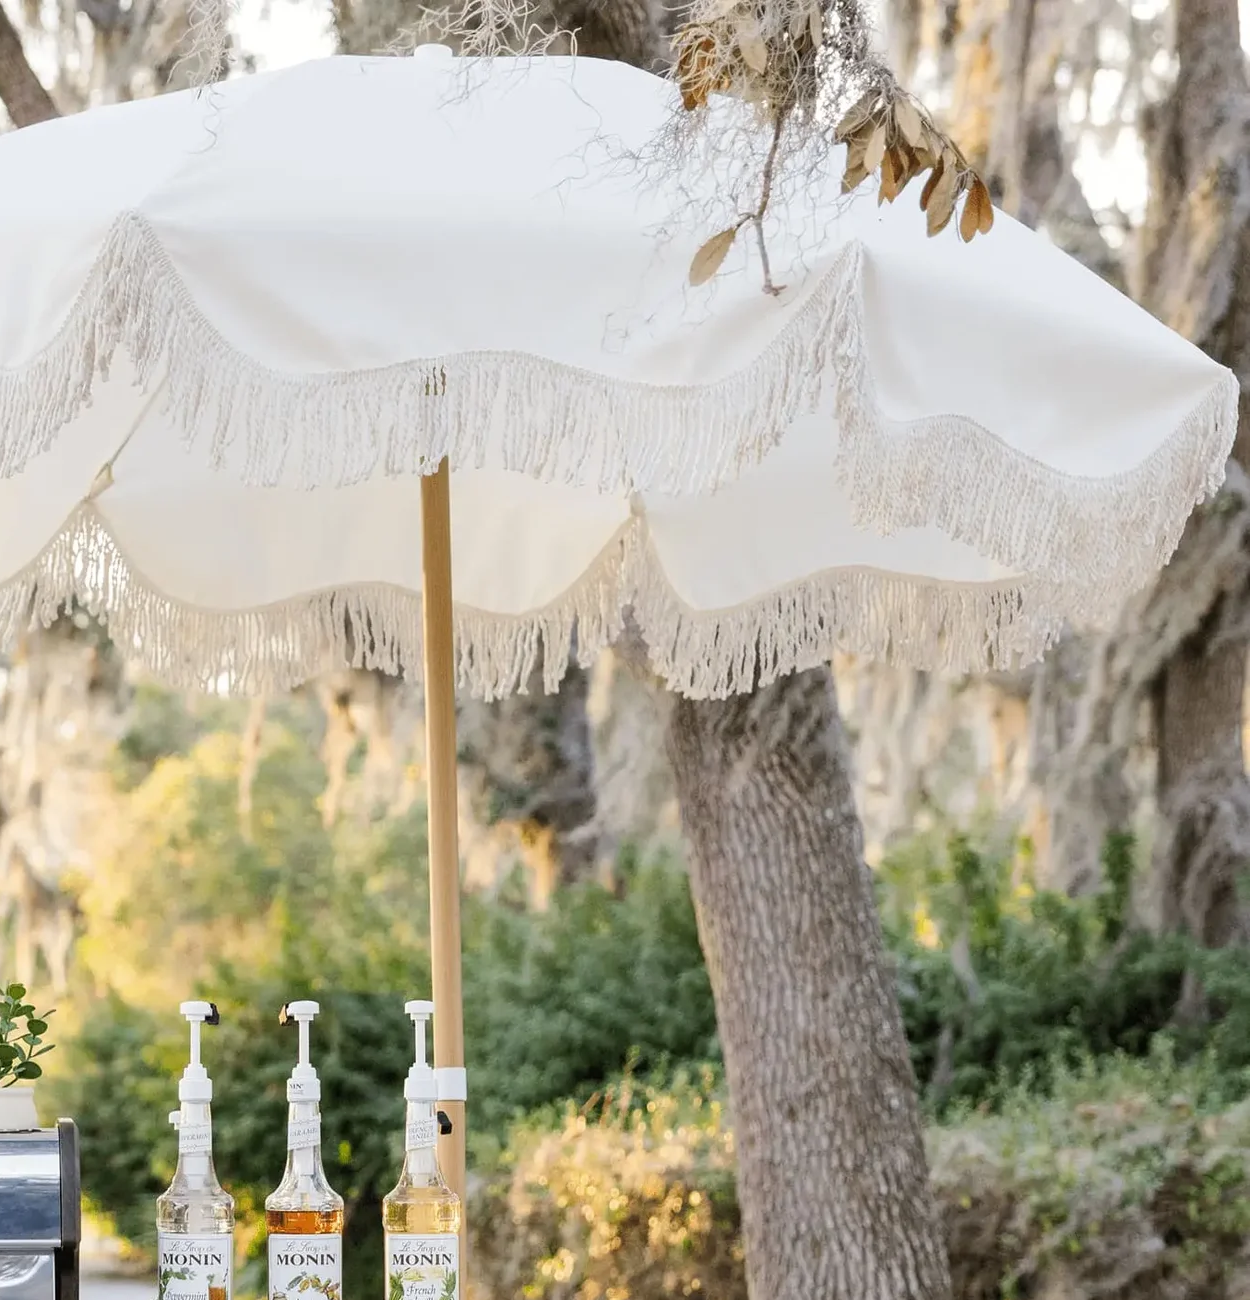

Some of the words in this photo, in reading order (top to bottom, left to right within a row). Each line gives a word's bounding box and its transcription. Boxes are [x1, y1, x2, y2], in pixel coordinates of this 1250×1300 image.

[163, 1253, 222, 1266] MONIN
[277, 1253, 335, 1266] MONIN
[392, 1253, 452, 1266] MONIN
[406, 1283, 436, 1296] French
